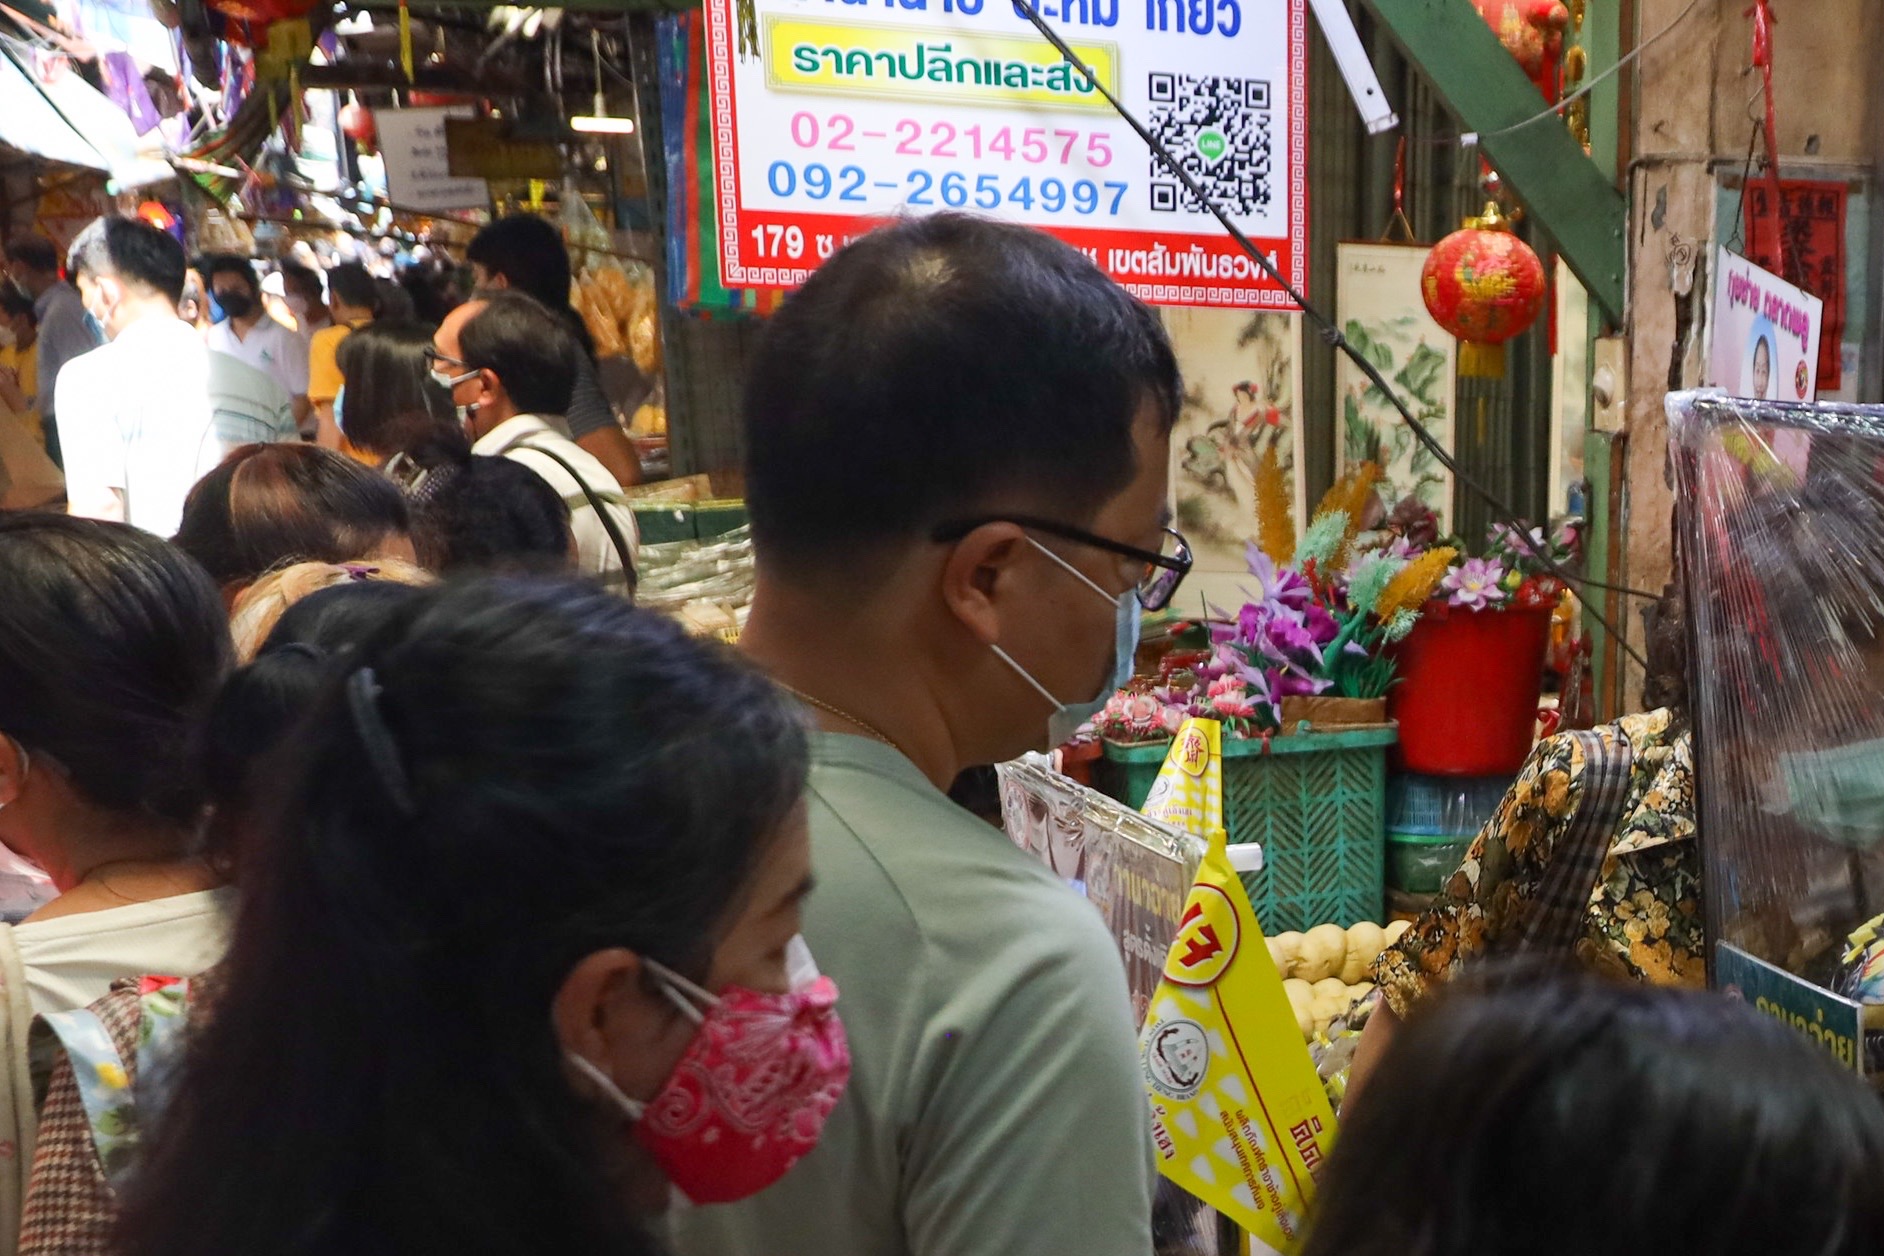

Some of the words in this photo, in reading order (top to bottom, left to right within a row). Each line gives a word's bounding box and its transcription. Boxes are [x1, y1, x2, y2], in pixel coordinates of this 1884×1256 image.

[794, 41, 1096, 95] ราคาปลีกและส่ง
[790, 110, 1113, 167] 02-2214575
[767, 159, 1130, 216] 092-2654997
[751, 224, 804, 259] 179
